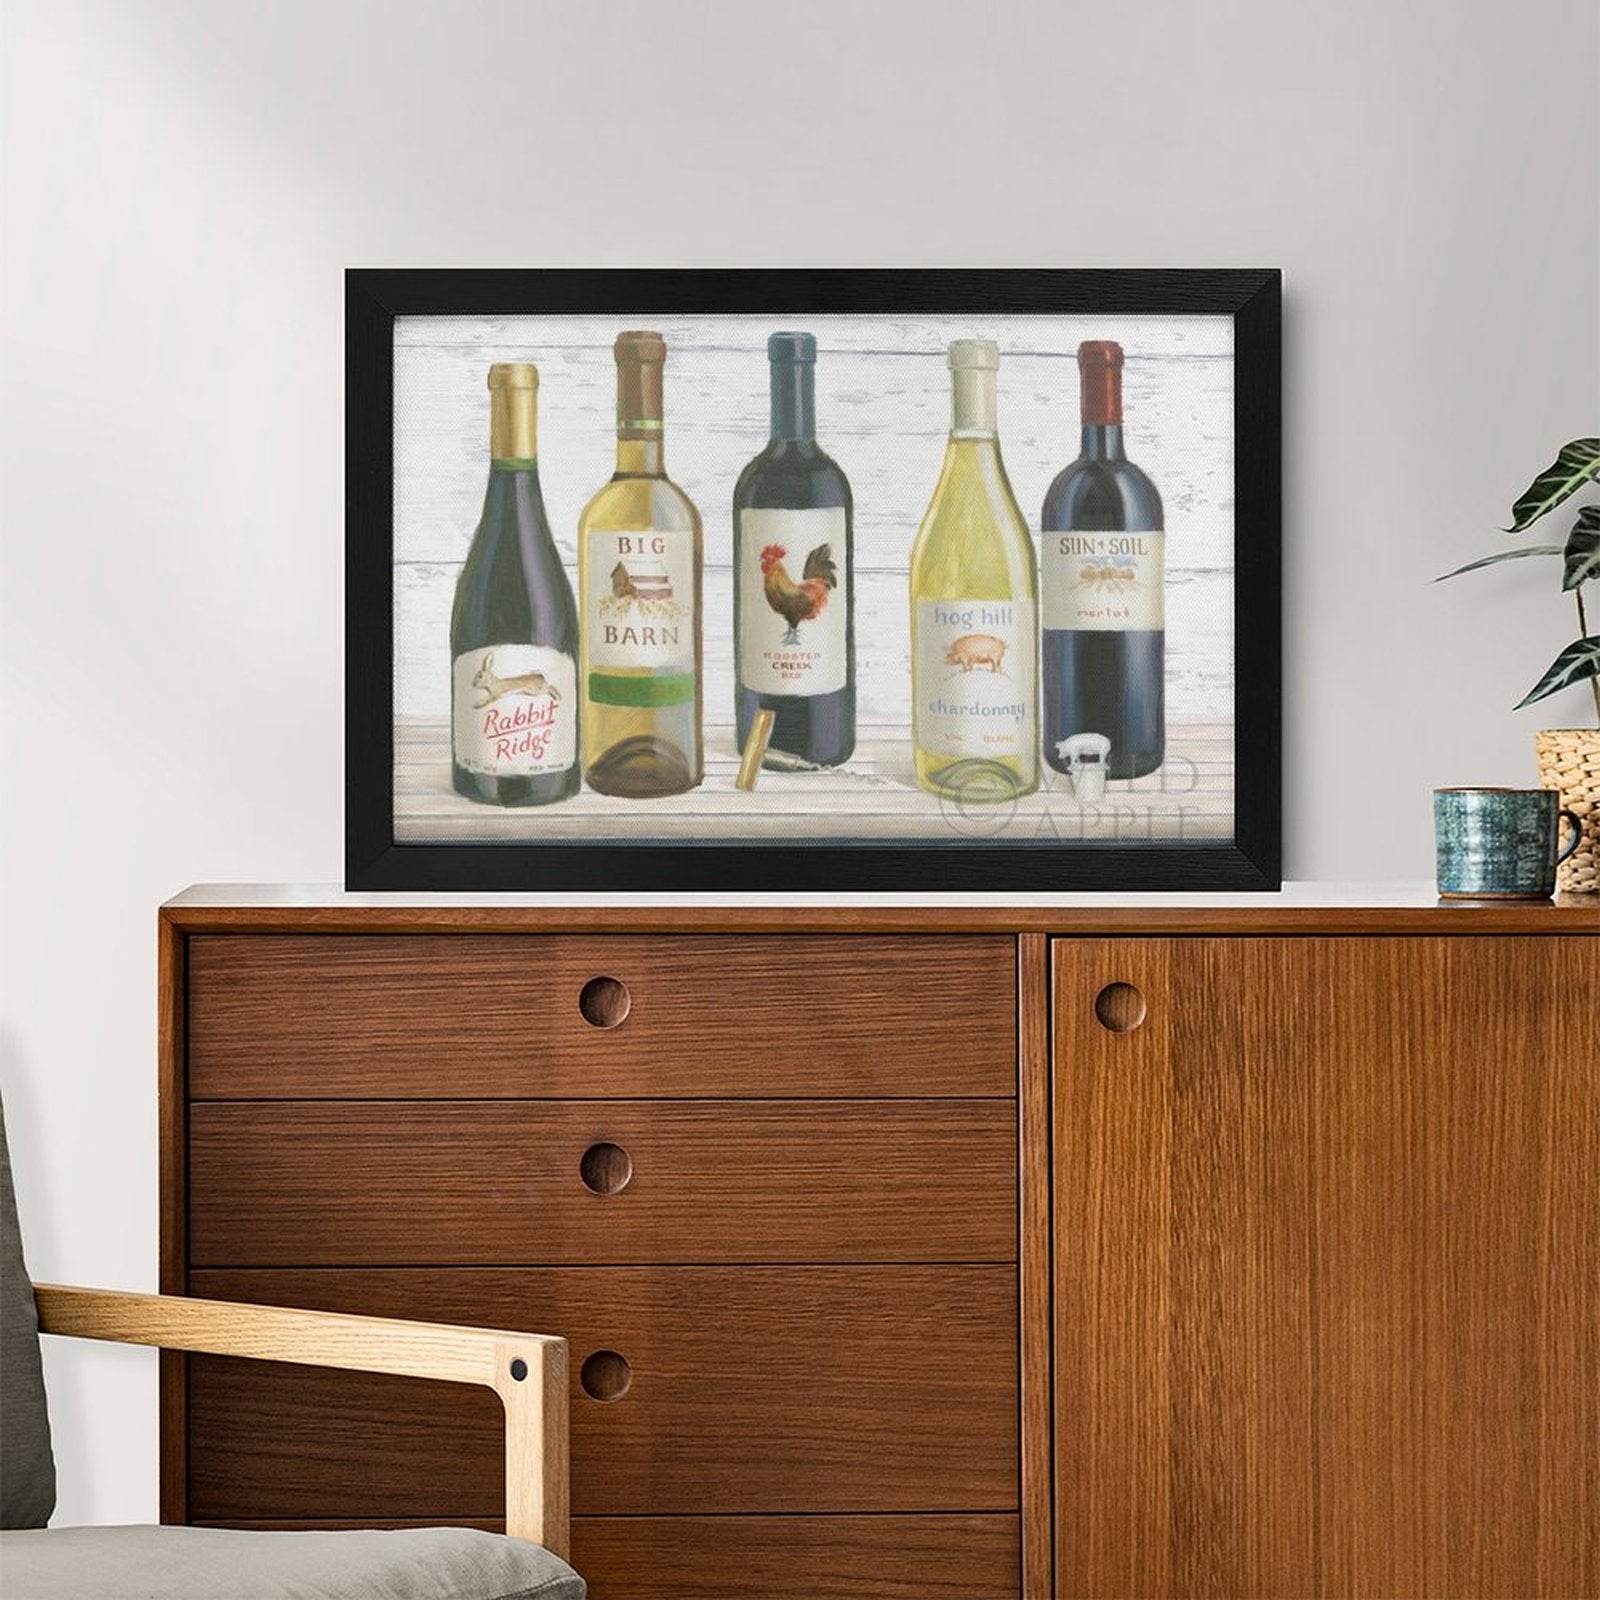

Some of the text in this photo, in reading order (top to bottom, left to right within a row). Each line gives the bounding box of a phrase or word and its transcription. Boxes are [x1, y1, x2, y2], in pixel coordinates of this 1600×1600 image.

[618, 536, 666, 555] BIG
[1059, 537, 1096, 556] SUN
[1108, 537, 1150, 556] SOIL
[933, 607, 1013, 631] hog hill
[603, 625, 679, 646] BARN
[772, 661, 812, 671] CREEK
[483, 700, 560, 735] Rabbit
[928, 698, 1026, 722] chardonnay
[496, 729, 553, 761] Ridge
